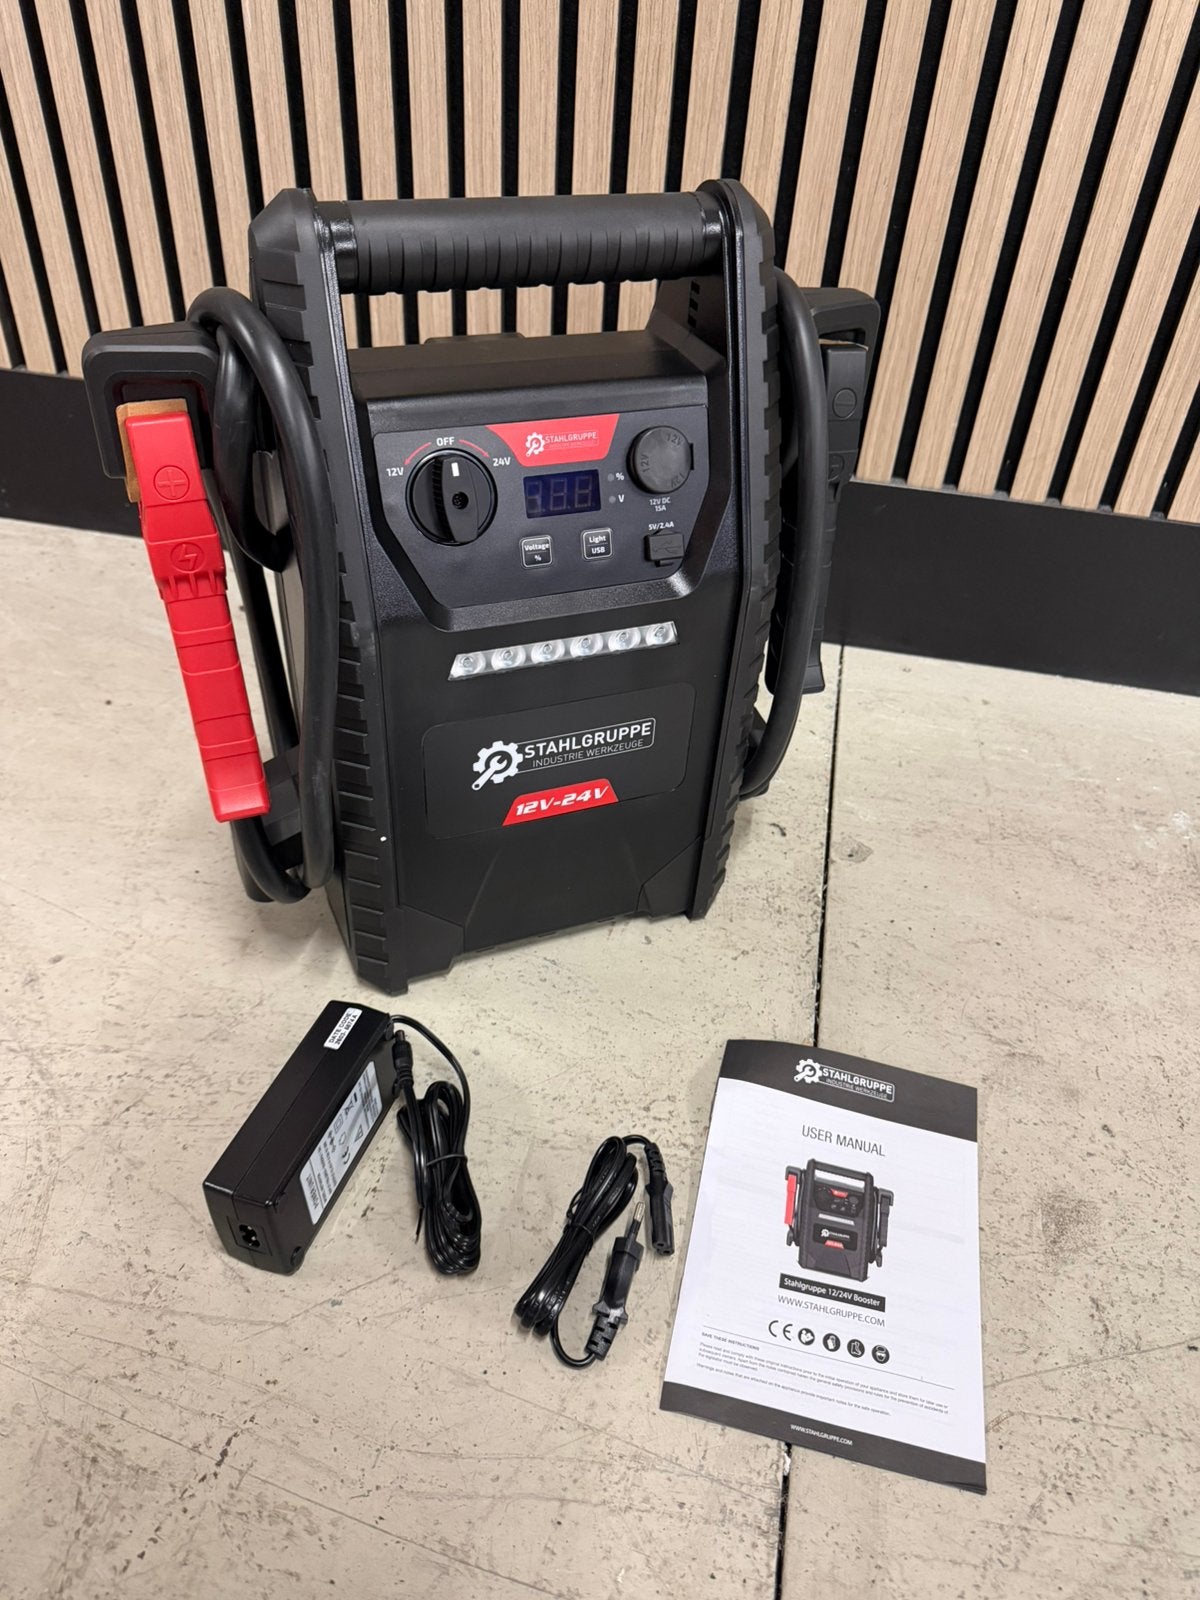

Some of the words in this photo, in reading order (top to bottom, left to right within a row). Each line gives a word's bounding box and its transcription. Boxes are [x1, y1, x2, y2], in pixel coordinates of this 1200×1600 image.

[436, 436, 455, 447] OFF
[545, 431, 597, 444] STAHLGRUPPE
[492, 456, 511, 467] 24V
[386, 466, 404, 477] 12V
[615, 472, 625, 481] %
[618, 494, 625, 503] V
[649, 498, 661, 506] 12V
[662, 496, 671, 504] DC
[648, 521, 675, 531] 5V/2.4A
[588, 535, 607, 544] Light
[524, 542, 550, 551] Voltage
[524, 721, 652, 759] STAHLGRUPPE
[532, 751, 584, 768] INDUSTRIE
[586, 738, 644, 758] WERKZEUGE
[515, 785, 610, 816] 12V-24V
[328, 1029, 341, 1043] DATE
[822, 1067, 893, 1095] STAHLGRUPPE
[826, 1078, 854, 1090] INDUSTRIE
[854, 1085, 888, 1099] WERKZEUGE
[801, 1124, 833, 1144] USER
[836, 1133, 886, 1157] MANUAL
[783, 1277, 827, 1295] Stahlgruppe
[828, 1287, 853, 1300] 12/24V
[853, 1293, 881, 1306] Booster
[778, 1294, 886, 1327] WWW.STAHLGRUPPE.COM
